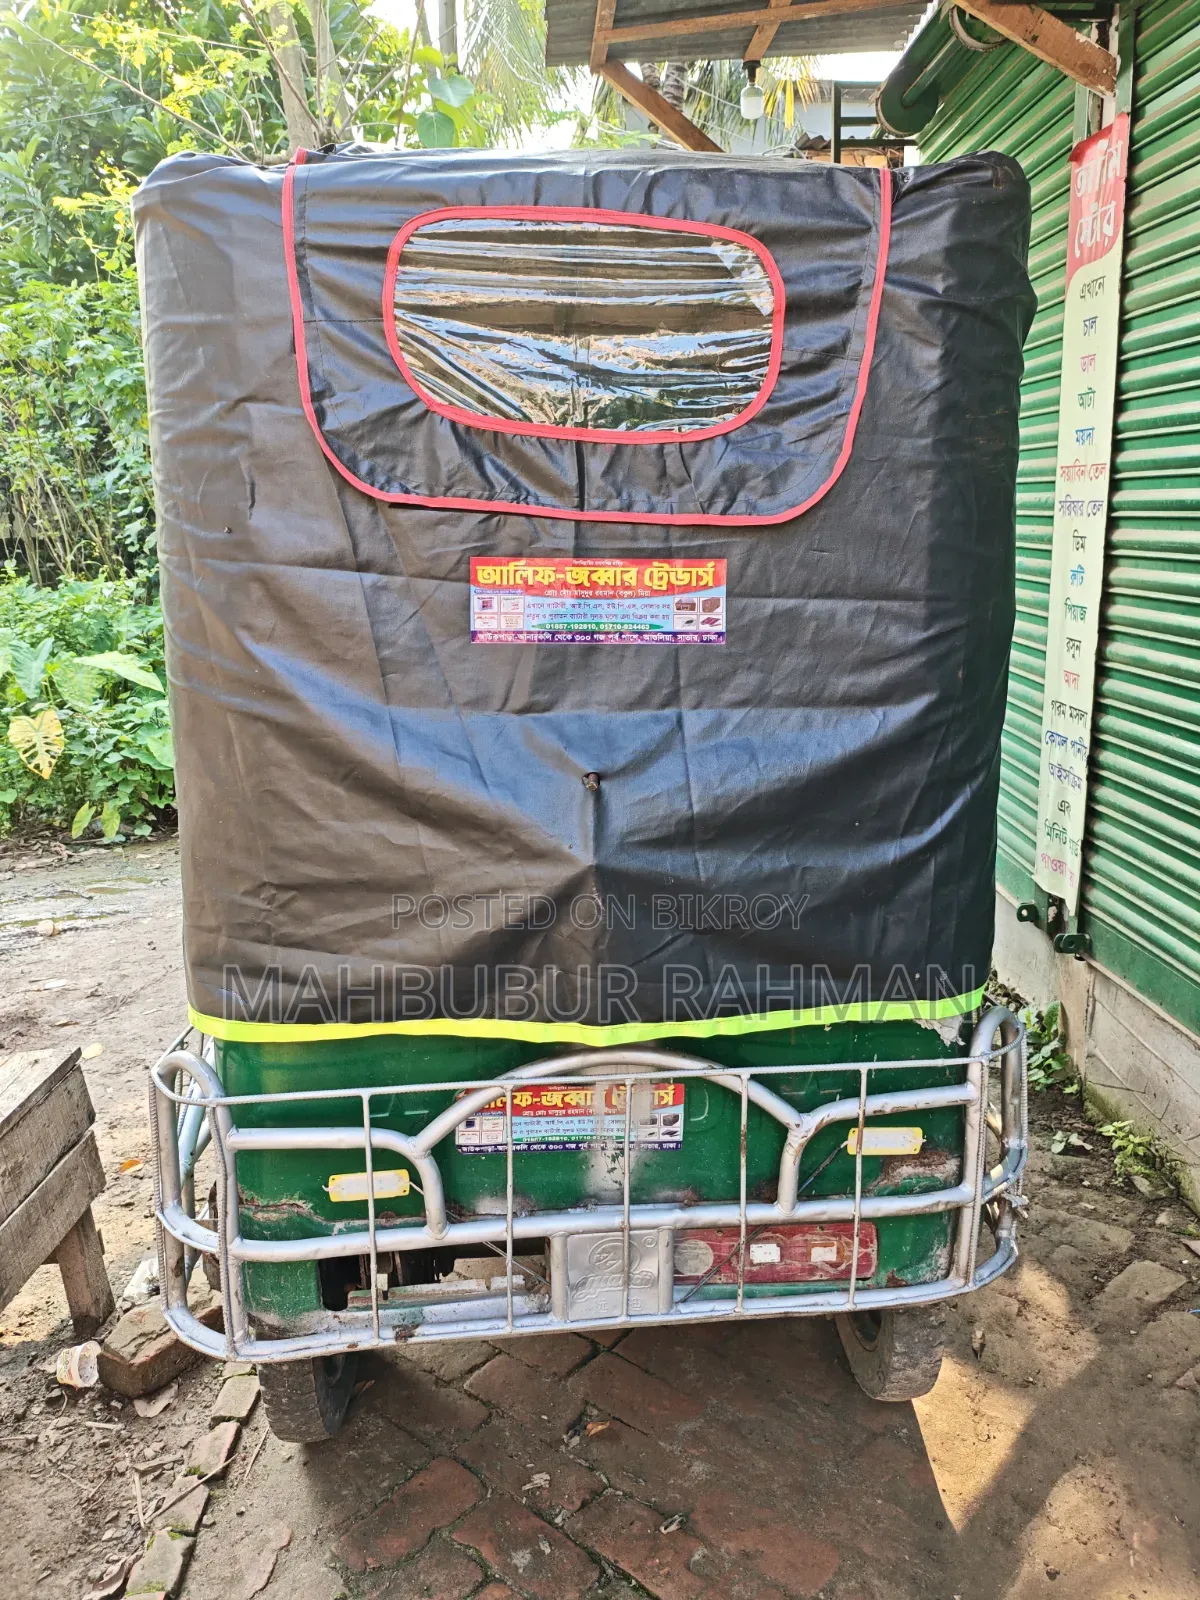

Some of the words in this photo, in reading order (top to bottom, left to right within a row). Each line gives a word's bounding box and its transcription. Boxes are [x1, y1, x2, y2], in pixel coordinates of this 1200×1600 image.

[1080, 275, 1106, 301] এখানে
[1083, 316, 1098, 336] চাল
[1080, 353, 1096, 373] ডাল
[1077, 387, 1096, 410] আটা
[1075, 427, 1095, 447] ময়দা
[1088, 462, 1107, 481] তেল
[1058, 494, 1085, 517] সরিষার
[1086, 499, 1104, 518] তেল
[1072, 529, 1087, 553] ডিম
[476, 560, 638, 587] আলিফ-জব্বার
[644, 561, 715, 591] ট্রেডার্স
[1066, 637, 1082, 660] রসুন
[1063, 669, 1080, 690] আদা
[1051, 700, 1067, 723] গরম
[1069, 705, 1088, 729] মসলা
